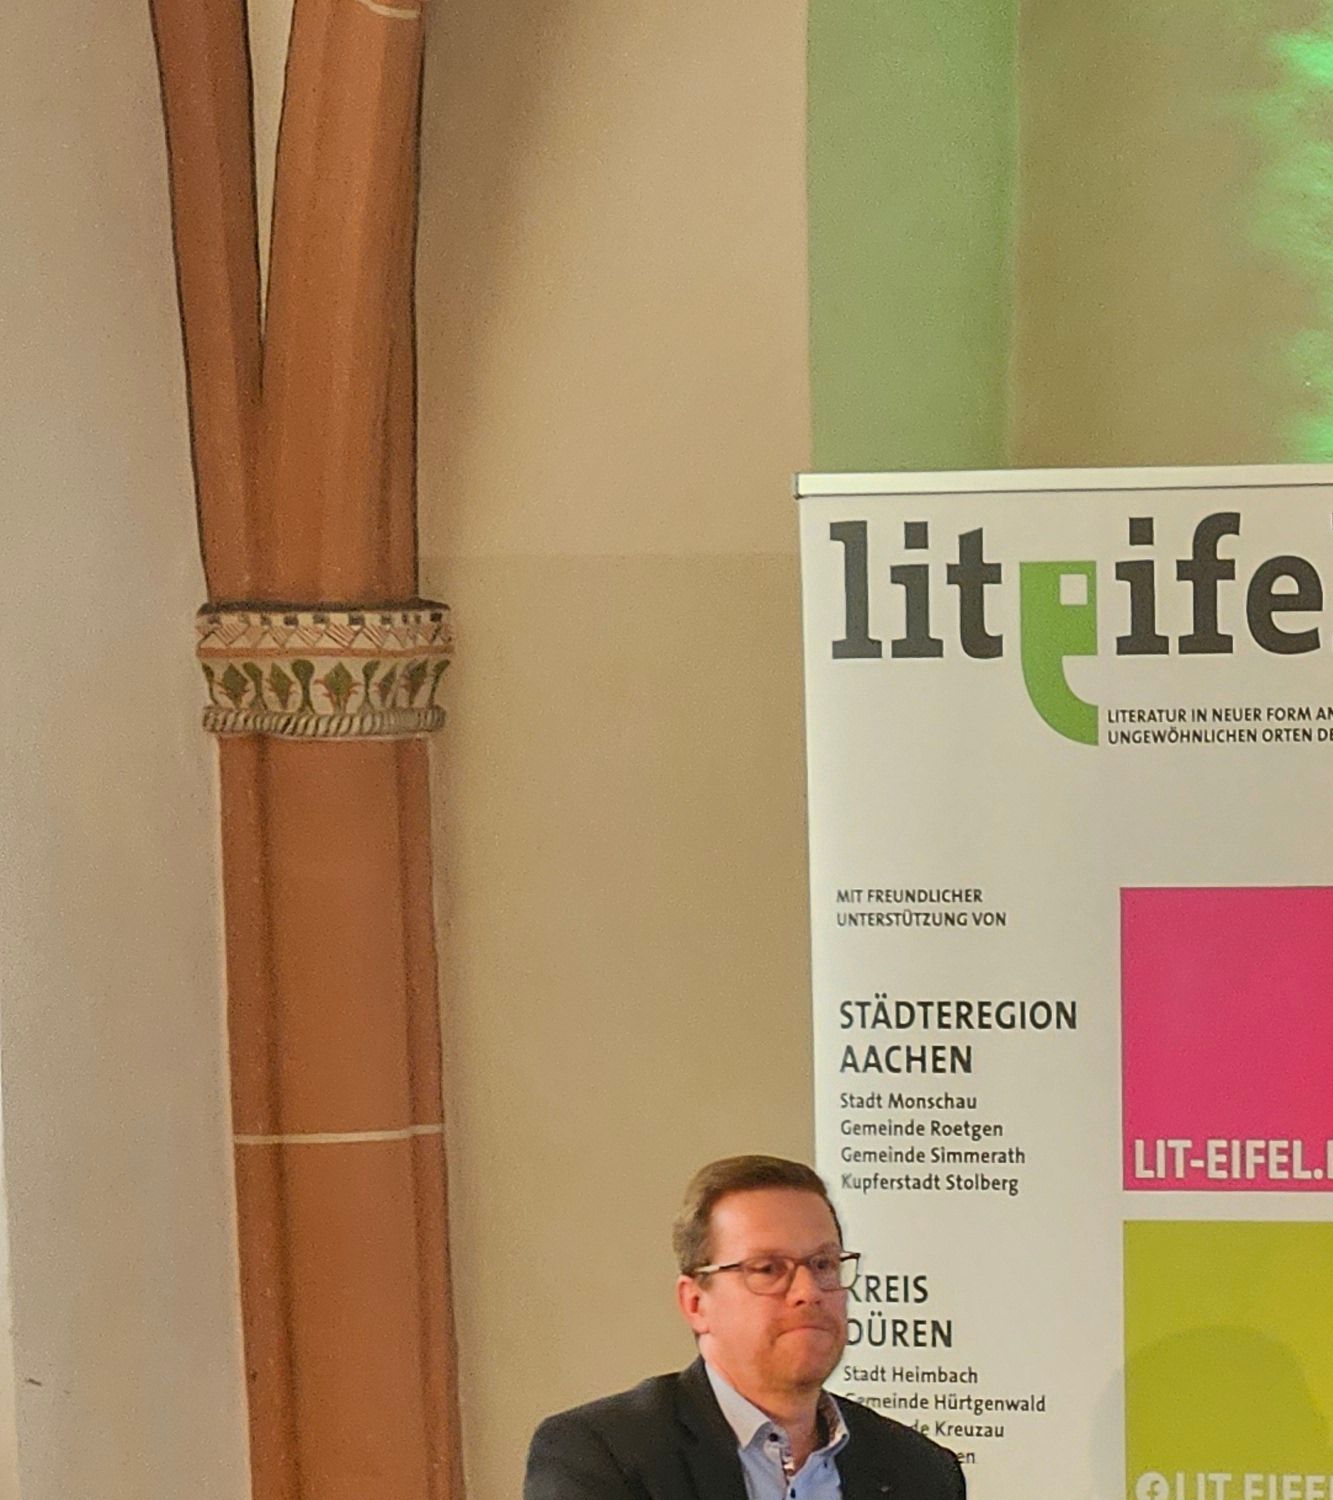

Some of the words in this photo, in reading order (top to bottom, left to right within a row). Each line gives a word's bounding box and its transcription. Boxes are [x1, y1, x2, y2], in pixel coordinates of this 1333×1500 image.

[1108, 709, 1186, 723] LITERATUR
[1191, 708, 1207, 722] IN
[1212, 708, 1262, 722] NEUER
[1267, 707, 1312, 722] FORM
[1108, 725, 1257, 744] UNGEWÖHNLICHEN
[1261, 728, 1313, 743] ORTEN
[836, 890, 863, 904] MIT
[867, 889, 983, 903] FREUNDLICHER
[836, 908, 968, 926] UNTERSTÜTZUNG
[972, 911, 1007, 926] VON
[840, 993, 1077, 1029] STÄDTEREGION
[840, 1045, 972, 1074] AACHEN
[841, 1093, 882, 1109] Stadt
[888, 1093, 977, 1109] Monschau
[841, 1119, 925, 1136] Gemeinde
[931, 1121, 1003, 1141] Roetgen
[841, 1146, 925, 1163] Gemeinde
[931, 1147, 1025, 1163] Simmerath
[842, 1173, 941, 1194] Kupferstadt
[947, 1174, 1019, 1196] Stolberg
[844, 1366, 886, 1382] Stadt
[892, 1367, 977, 1383] Heimbach
[935, 1393, 1045, 1415] Hürtgenwald
[935, 1421, 1004, 1437] Kreuzau
